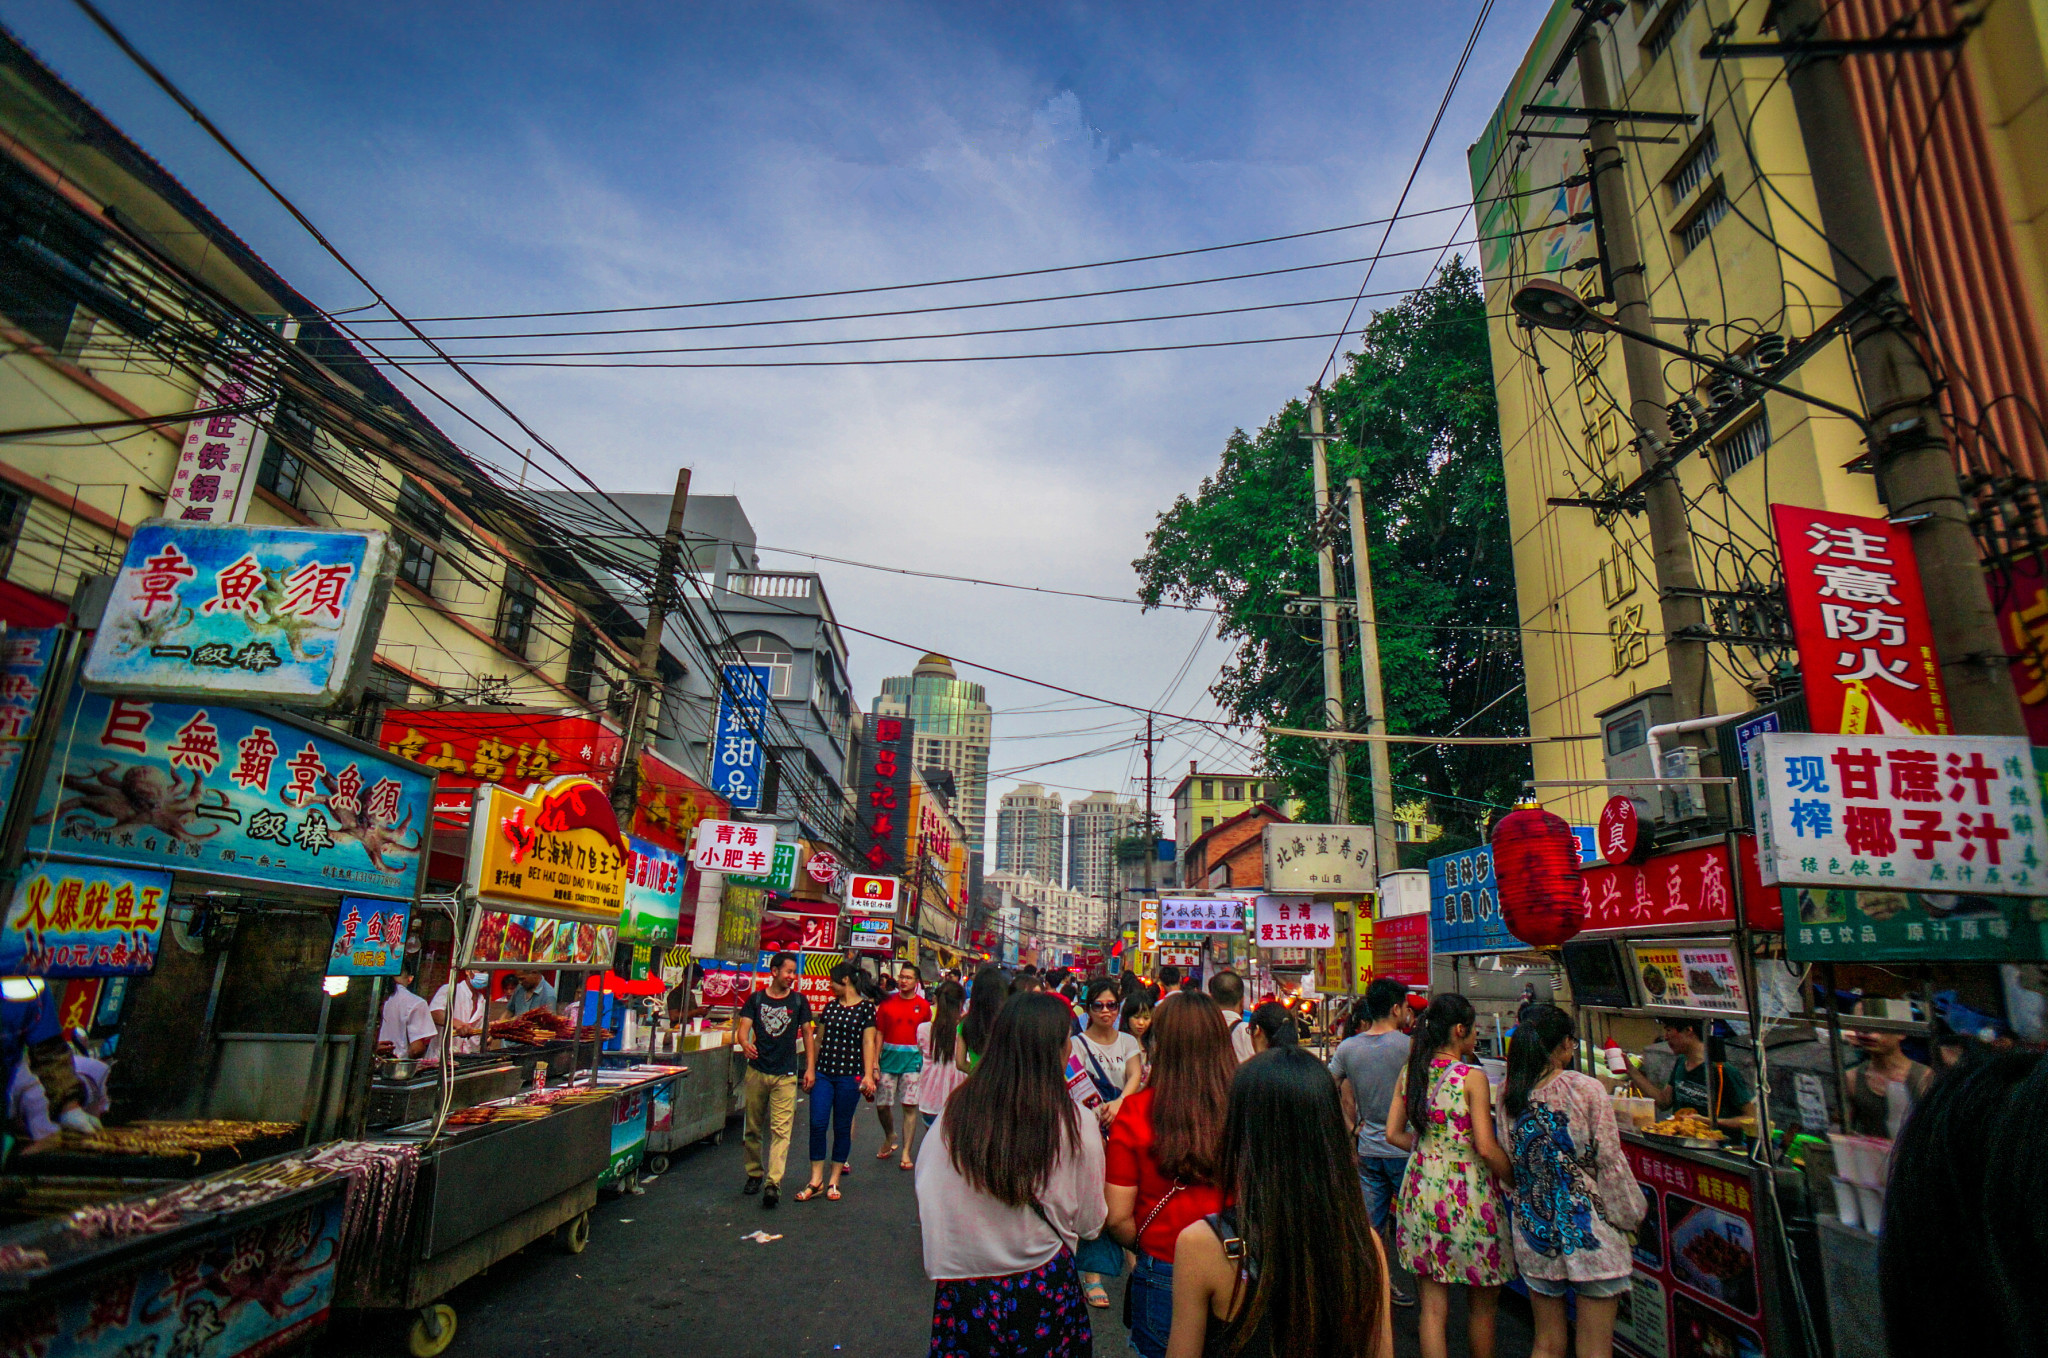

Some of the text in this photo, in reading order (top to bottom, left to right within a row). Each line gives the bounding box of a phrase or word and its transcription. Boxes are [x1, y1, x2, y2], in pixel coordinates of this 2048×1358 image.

[130, 544, 355, 620] 章魚須
[1804, 522, 1921, 690] 注意防火
[151, 643, 281, 672] 一級棒
[100, 700, 404, 824] 巨無霸章魚須
[1830, 747, 1999, 806] 甘蔗汁
[1785, 756, 1833, 838] 现榨
[195, 803, 335, 855] 一級棒
[716, 825, 759, 847] 青海
[1843, 806, 2010, 865] 椰子汁
[531, 833, 621, 881] 北海秋刀鱼王子
[700, 847, 766, 871] 小肥羊
[1445, 851, 1498, 890] 桂林步
[1800, 857, 1897, 878] 绿色饮品
[528, 866, 541, 880] BEI
[543, 869, 556, 883] HAI
[558, 872, 571, 885] QIU
[573, 876, 585, 889] DAO
[1309, 873, 1342, 884] 中山店
[15, 876, 163, 933] 火爆鱿鱼王
[1279, 903, 1311, 920] 台湾
[1444, 887, 1504, 926] 章魚小
[1261, 923, 1331, 941] 爱玉柠檬冰
[1799, 924, 1878, 945] 绿色饮品
